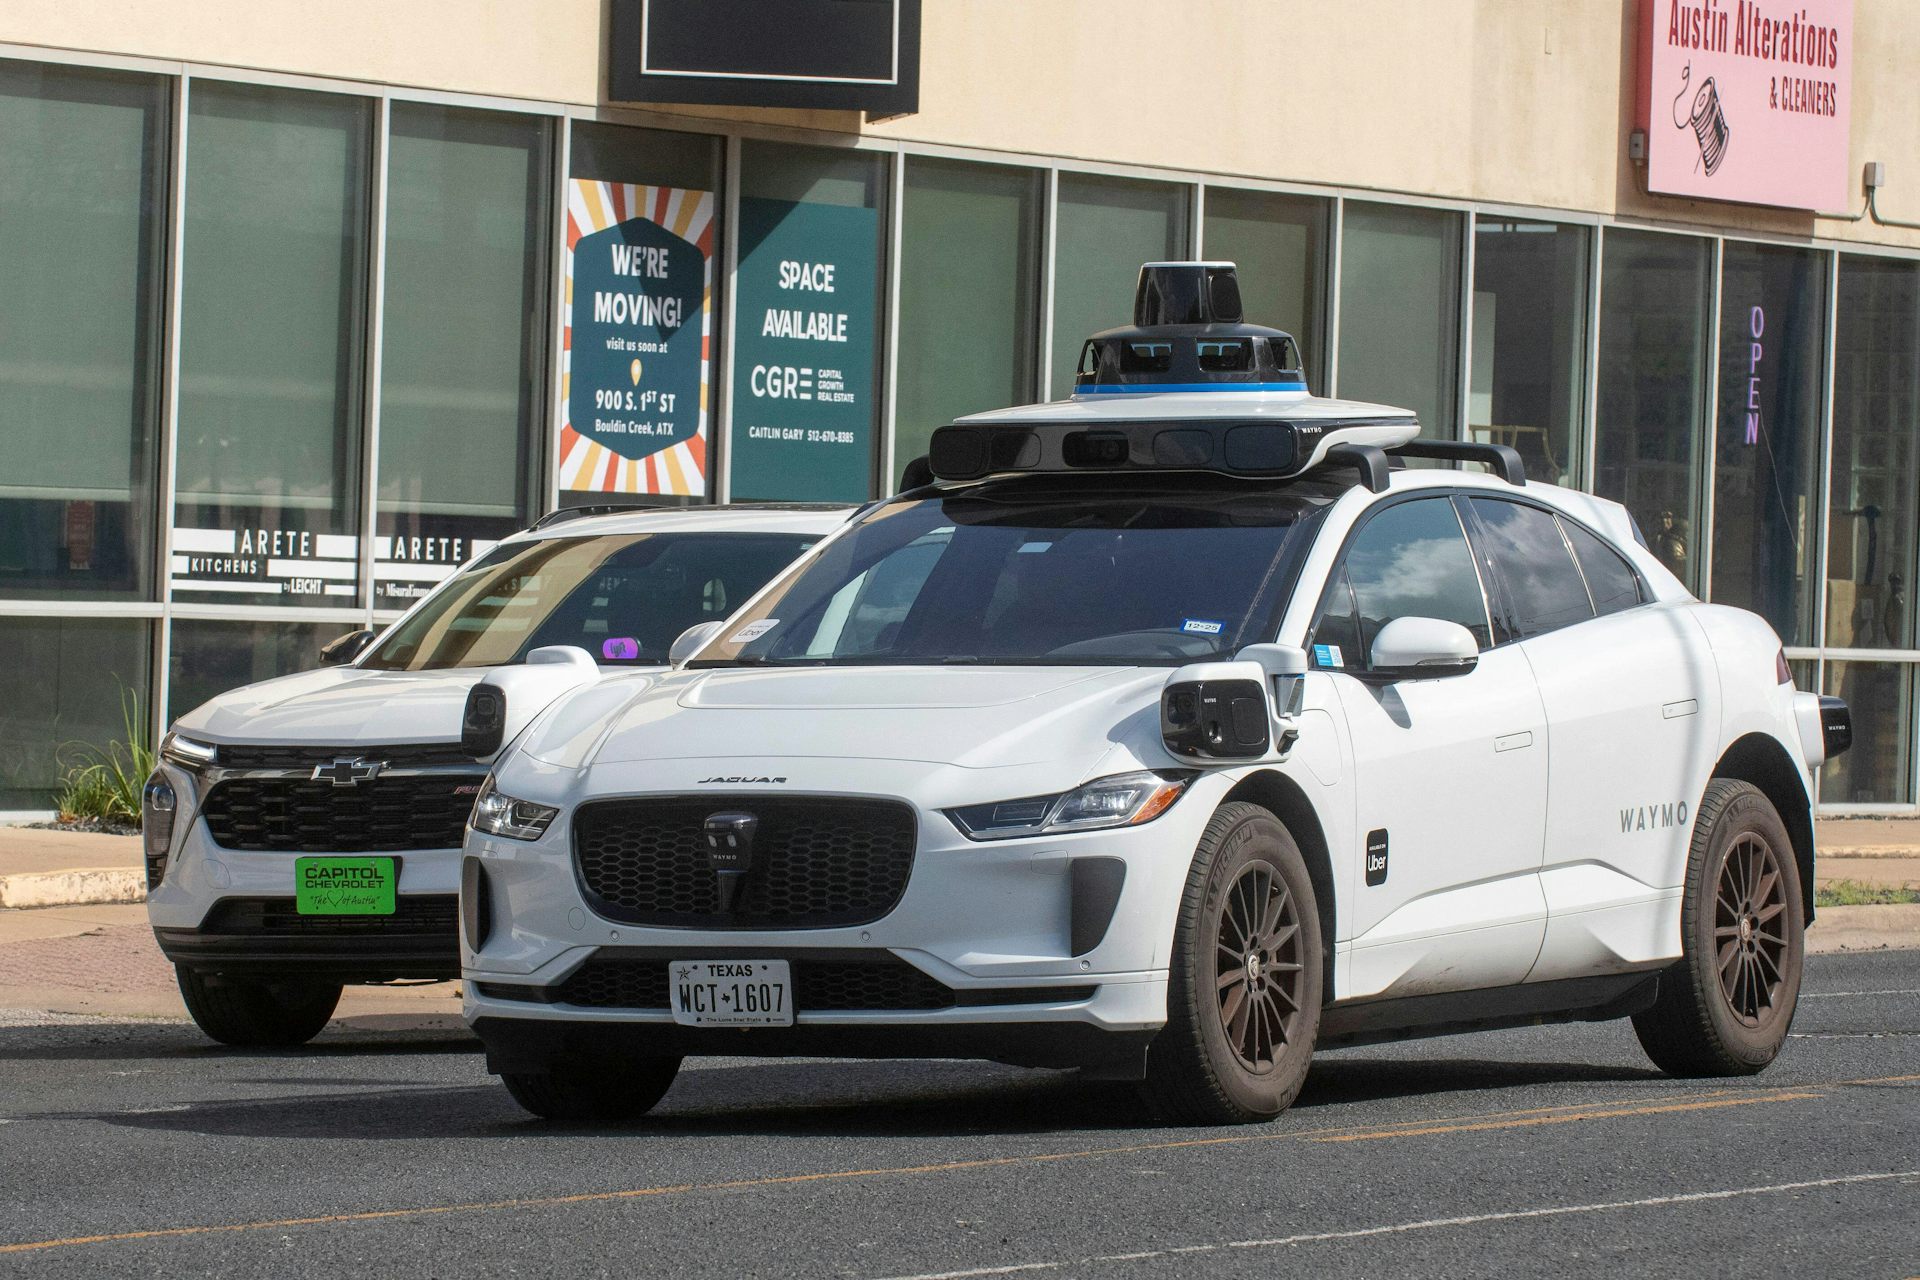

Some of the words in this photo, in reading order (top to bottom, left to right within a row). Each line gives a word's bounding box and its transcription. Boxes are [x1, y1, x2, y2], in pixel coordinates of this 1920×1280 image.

[1668, 0, 1728, 53] Austin
[1734, 0, 1838, 70] Alterations
[1769, 76, 1778, 110] &
[1781, 76, 1837, 118] CLEANERS
[611, 243, 669, 279] WE'RE
[778, 260, 835, 293] SPACE
[594, 291, 682, 328] MOVING!
[762, 308, 848, 342] AVAILABLE
[606, 337, 625, 351] visit
[626, 341, 636, 352] us
[637, 342, 657, 353] soon
[658, 342, 668, 354] at
[818, 369, 843, 380] CAPITAL
[1744, 306, 1765, 445] OPEN
[818, 380, 844, 391] GROWTH
[595, 389, 622, 411] 900
[624, 390, 638, 412] S.
[659, 392, 676, 414] ST
[817, 392, 833, 402] REAL
[834, 392, 855, 403] ESTATE
[595, 418, 627, 434] Bouldin
[628, 420, 655, 436] Creek,
[656, 422, 674, 436] ATX
[749, 426, 780, 440] CAITLIN
[782, 428, 804, 441] GARY
[1301, 426, 1323, 434] WAYMO
[240, 528, 310, 557] ARETE
[394, 536, 462, 562] ARETE
[191, 557, 257, 575] KITCHENS
[283, 581, 291, 593] by
[290, 578, 323, 595] LEICHT
[697, 776, 788, 784] JAGUAR
[1620, 801, 1688, 833] WAYMO
[1368, 854, 1386, 871] Uber
[305, 867, 384, 879] CAPITOL
[305, 880, 385, 889] CHEVROLET
[707, 964, 753, 977] TEXAS
[679, 983, 718, 1013] WCT
[731, 983, 783, 1013] 1607
